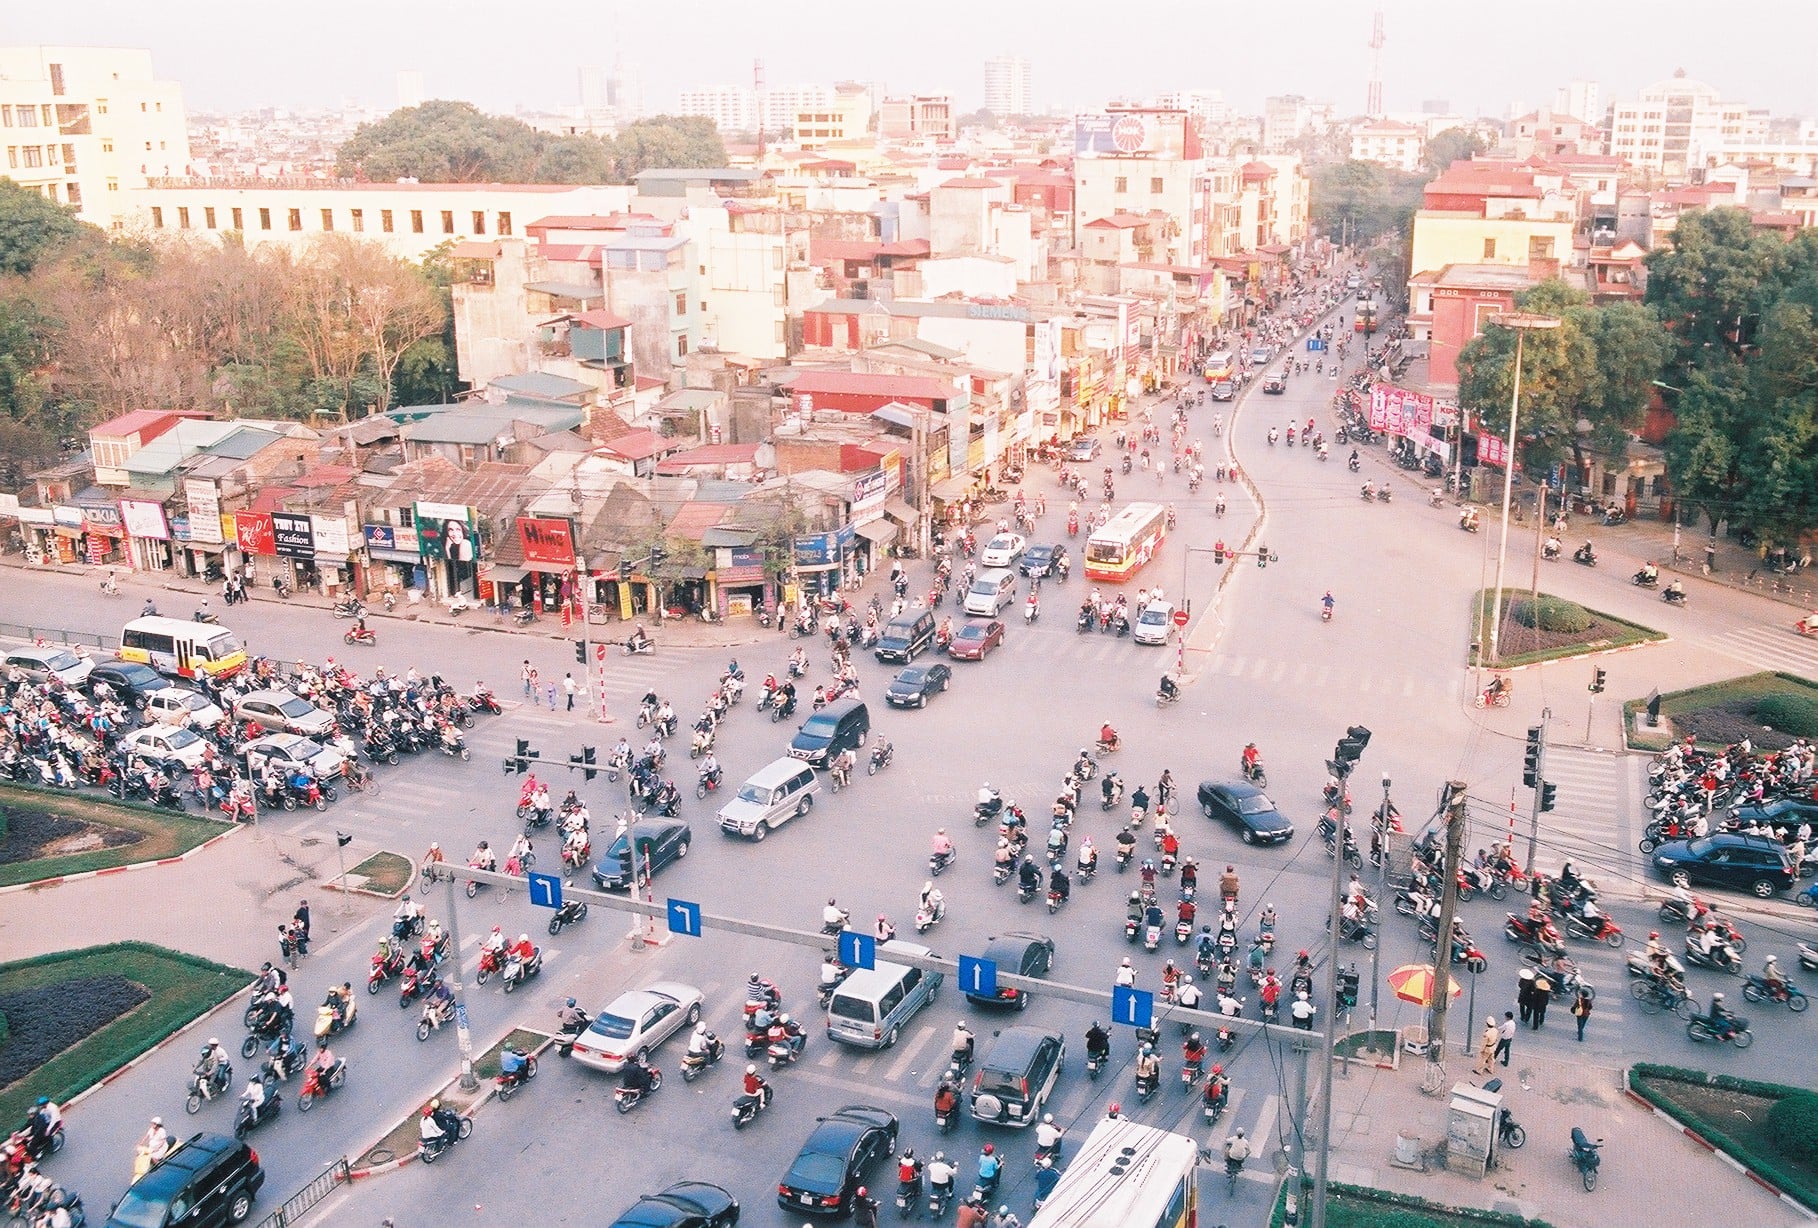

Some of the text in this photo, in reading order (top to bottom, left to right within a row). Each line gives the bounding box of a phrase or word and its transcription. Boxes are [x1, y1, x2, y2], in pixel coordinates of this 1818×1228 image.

[969, 304, 1027, 319] SIEMENS
[80, 508, 119, 523] NOKIA
[277, 533, 309, 545] Fashion
[282, 556, 292, 588] NOKIA
